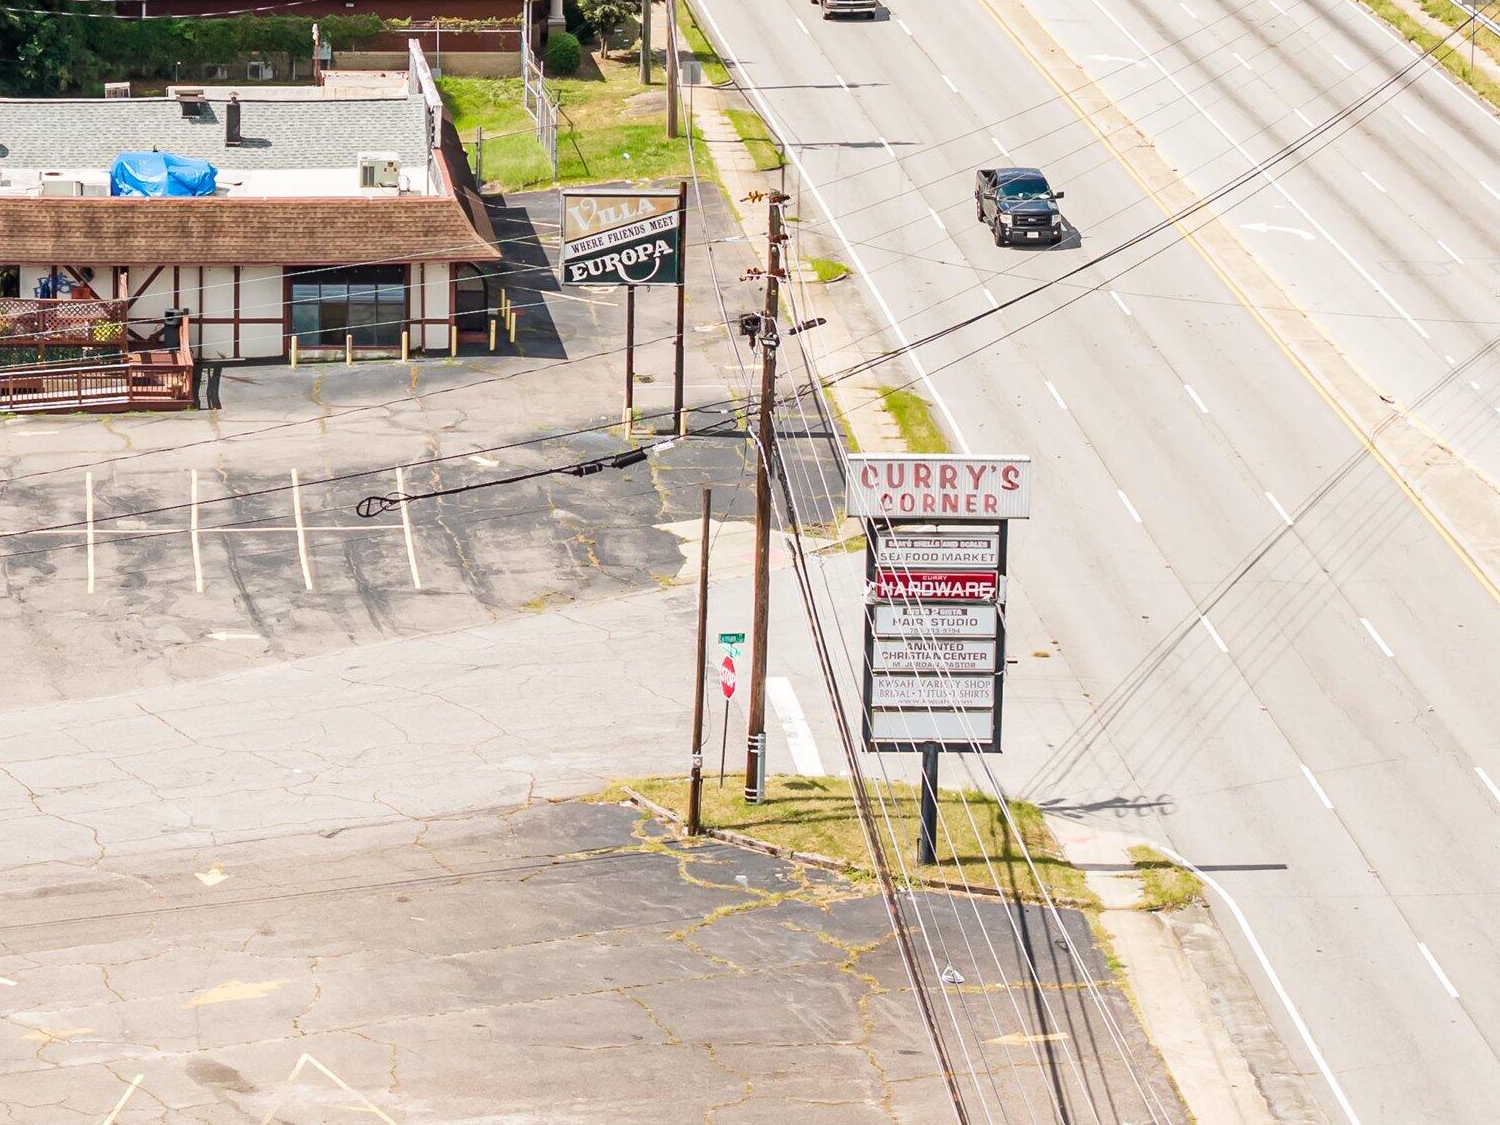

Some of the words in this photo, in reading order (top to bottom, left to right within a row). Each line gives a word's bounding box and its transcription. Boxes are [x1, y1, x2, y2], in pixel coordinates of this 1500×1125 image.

[567, 197, 656, 231] VILLA
[571, 236, 605, 254] WHERE
[608, 224, 646, 243] FRIENDS
[649, 216, 675, 230] MEET
[569, 239, 674, 283] EUROPA
[861, 462, 1020, 492] CURRY'S
[880, 493, 998, 514] CORNER
[941, 553, 996, 562] MARKET
[880, 581, 996, 598] HARDWARE
[892, 618, 924, 627] HAIR
[931, 618, 978, 627] STUDIO
[905, 642, 964, 651] ANOINTED
[882, 651, 941, 661] CHRISTIAN
[943, 652, 988, 661] CENTER
[964, 680, 991, 689] SHOP
